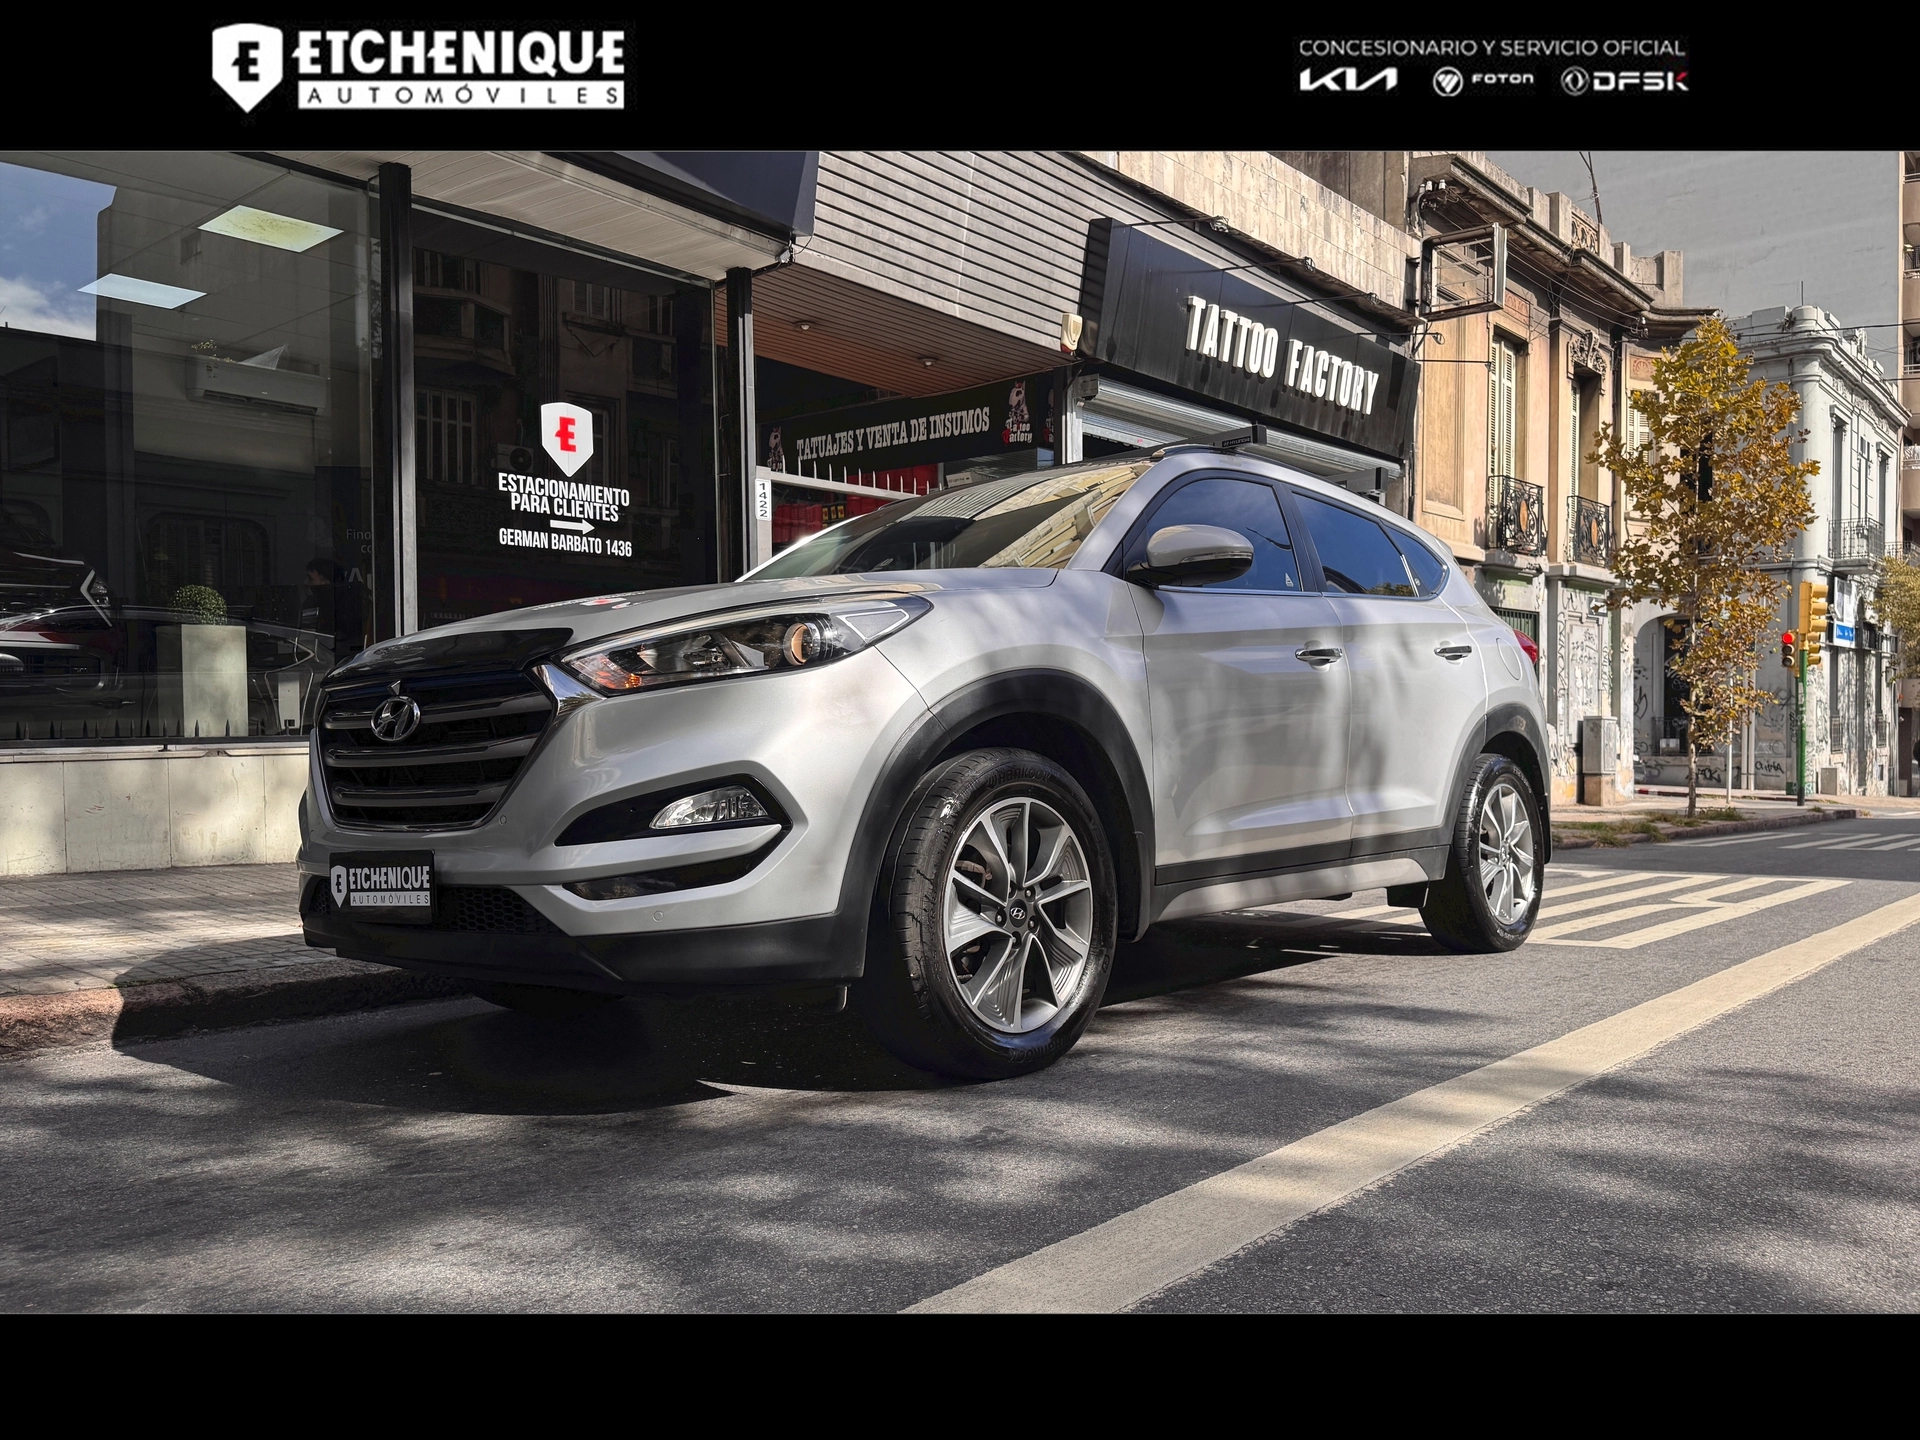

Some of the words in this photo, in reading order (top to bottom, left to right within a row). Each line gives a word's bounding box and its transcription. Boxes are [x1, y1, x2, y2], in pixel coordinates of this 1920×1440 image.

[1185, 295, 1279, 379] TATTOO
[1284, 339, 1380, 415] FACTORY
[796, 429, 854, 461] TATUAJES
[856, 428, 866, 452] Y
[866, 419, 909, 450] VENTA
[910, 417, 928, 443] DE
[929, 406, 991, 440] INSUMOS
[498, 472, 630, 507] ESTACIONAMIENTO
[758, 482, 768, 518] 1422
[510, 492, 551, 515] PARA
[553, 498, 619, 522] CLIENTES
[499, 527, 549, 549] GERMAN
[551, 533, 602, 554] BARBATO
[605, 539, 632, 558] 1436
[349, 865, 430, 890] ETCHENIQUE
[352, 892, 430, 905] AUTOMÓVILES
